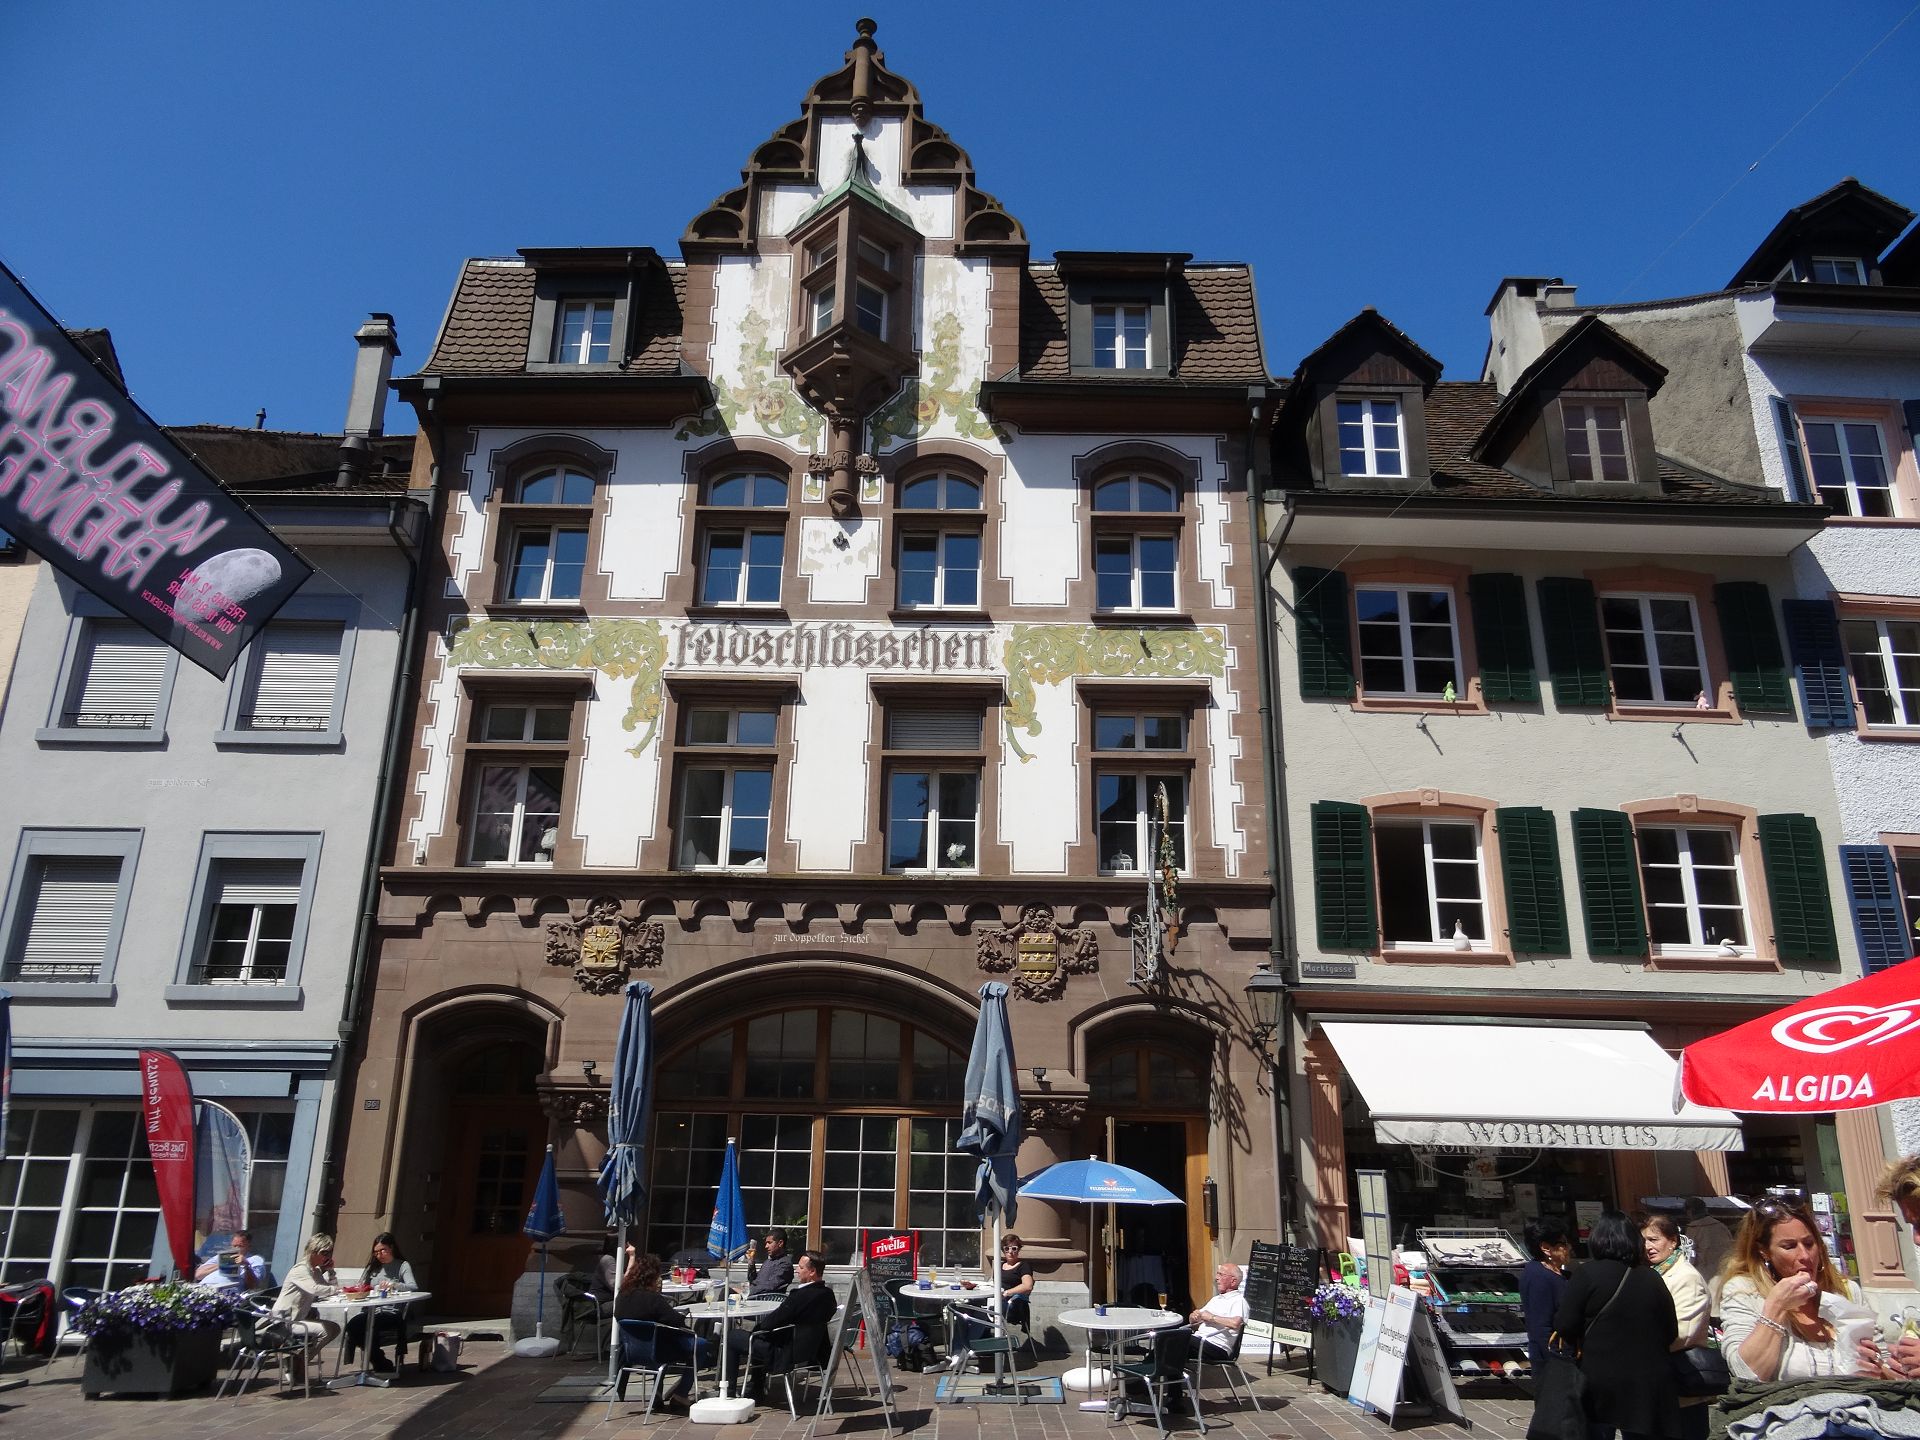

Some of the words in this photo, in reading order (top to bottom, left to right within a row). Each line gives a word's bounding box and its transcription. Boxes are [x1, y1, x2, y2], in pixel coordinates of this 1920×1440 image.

[1303, 963, 1353, 975] Marktgasse
[1752, 1073, 1874, 1102] ALGIDA
[1463, 1122, 1658, 1147] WOHNHUUS
[876, 1239, 906, 1254] rivella
